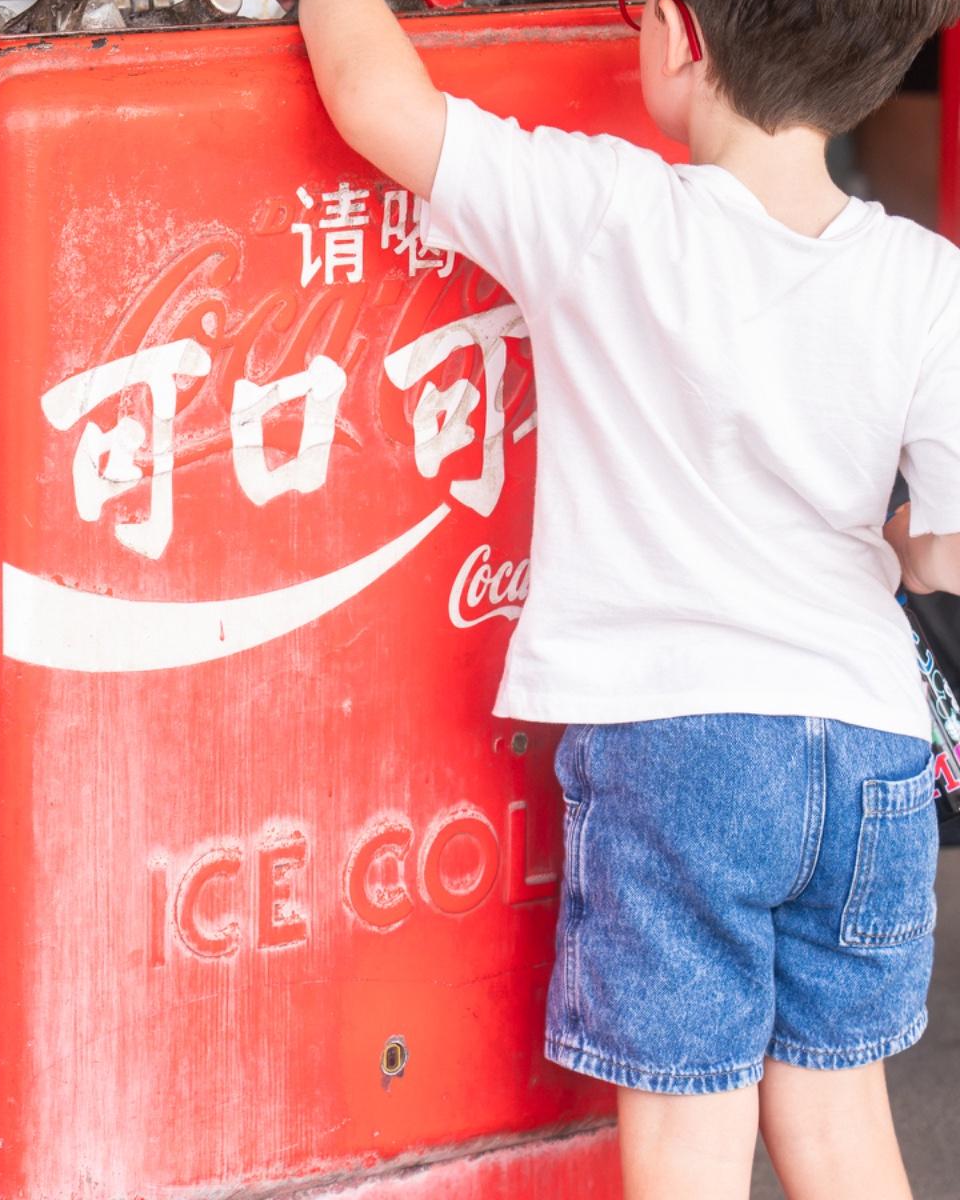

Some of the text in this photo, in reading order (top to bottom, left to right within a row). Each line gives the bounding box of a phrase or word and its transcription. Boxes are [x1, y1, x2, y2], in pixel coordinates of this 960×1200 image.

[40, 303, 539, 561] 可口可
[145, 802, 561, 968] ICE COL
